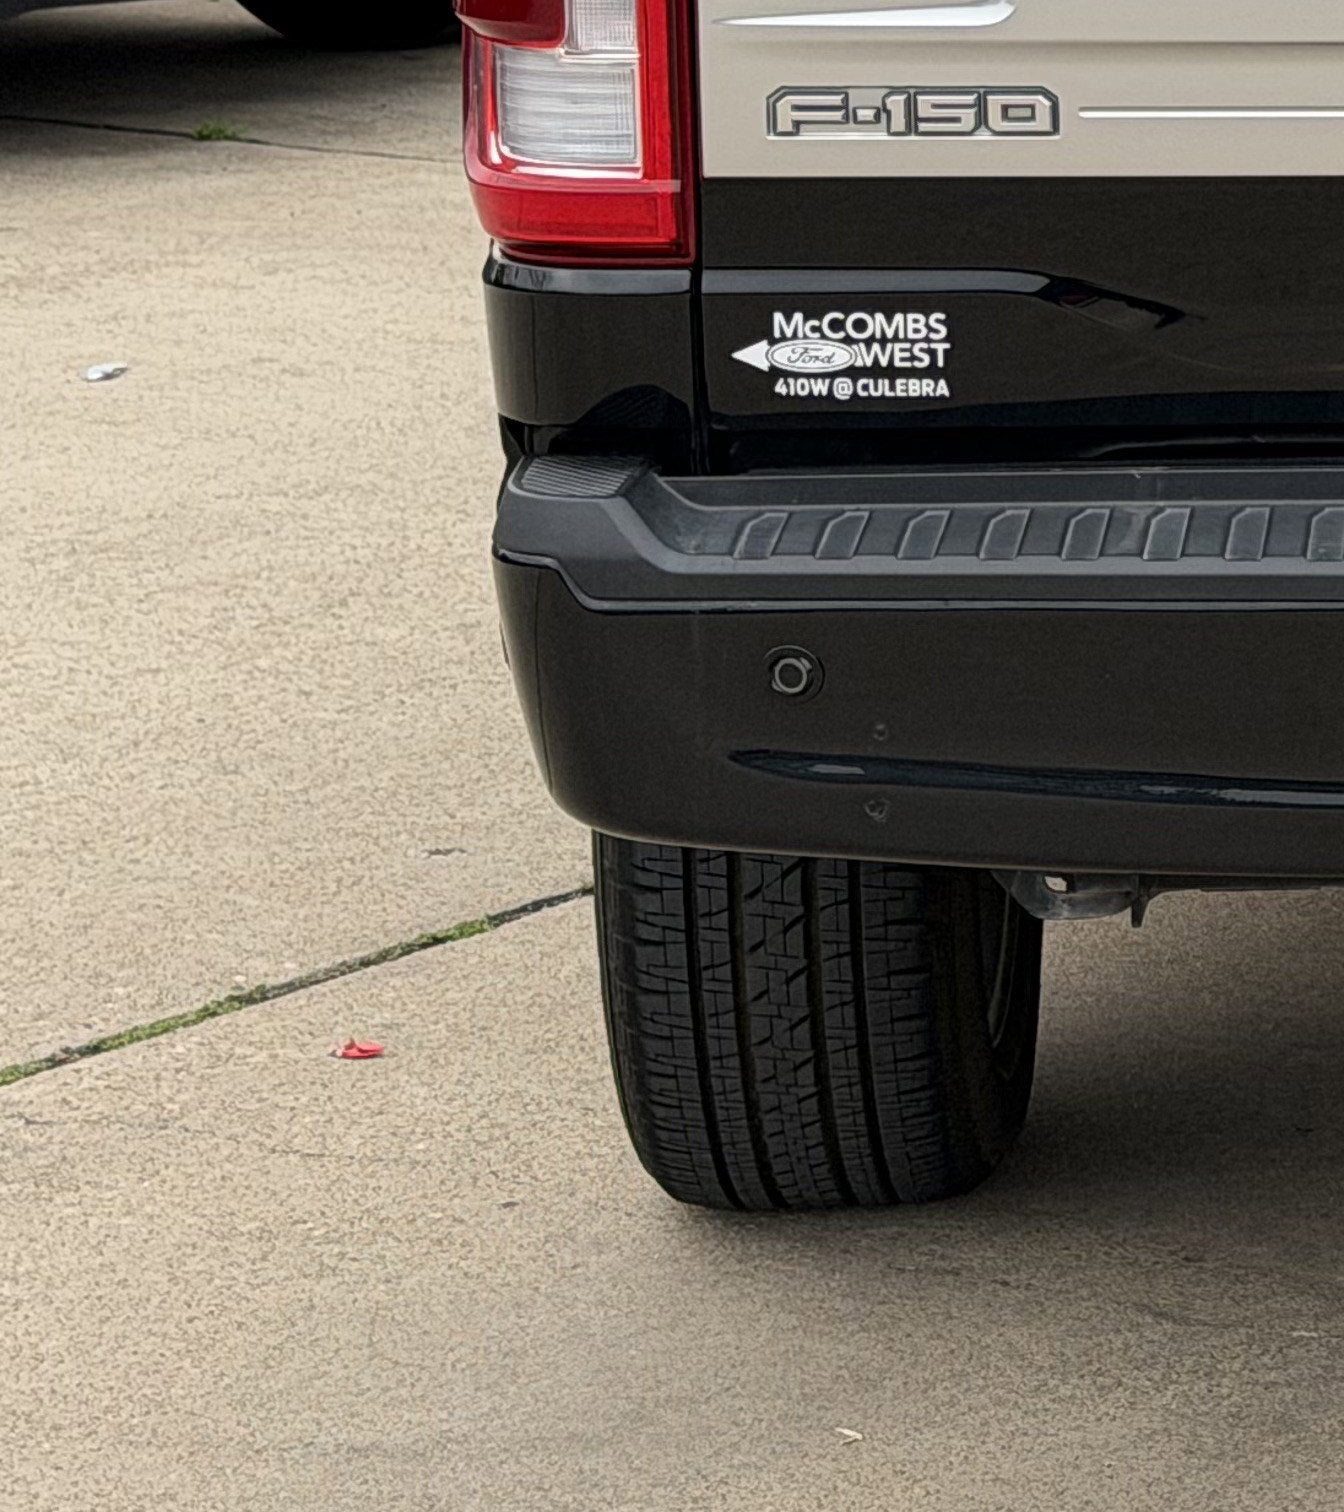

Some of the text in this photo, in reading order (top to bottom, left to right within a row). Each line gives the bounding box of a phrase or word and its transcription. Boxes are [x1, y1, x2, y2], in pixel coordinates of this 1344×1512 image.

[766, 86, 1061, 139] F-150
[773, 311, 948, 339] McCOMBS
[786, 342, 951, 368] Ford WEST
